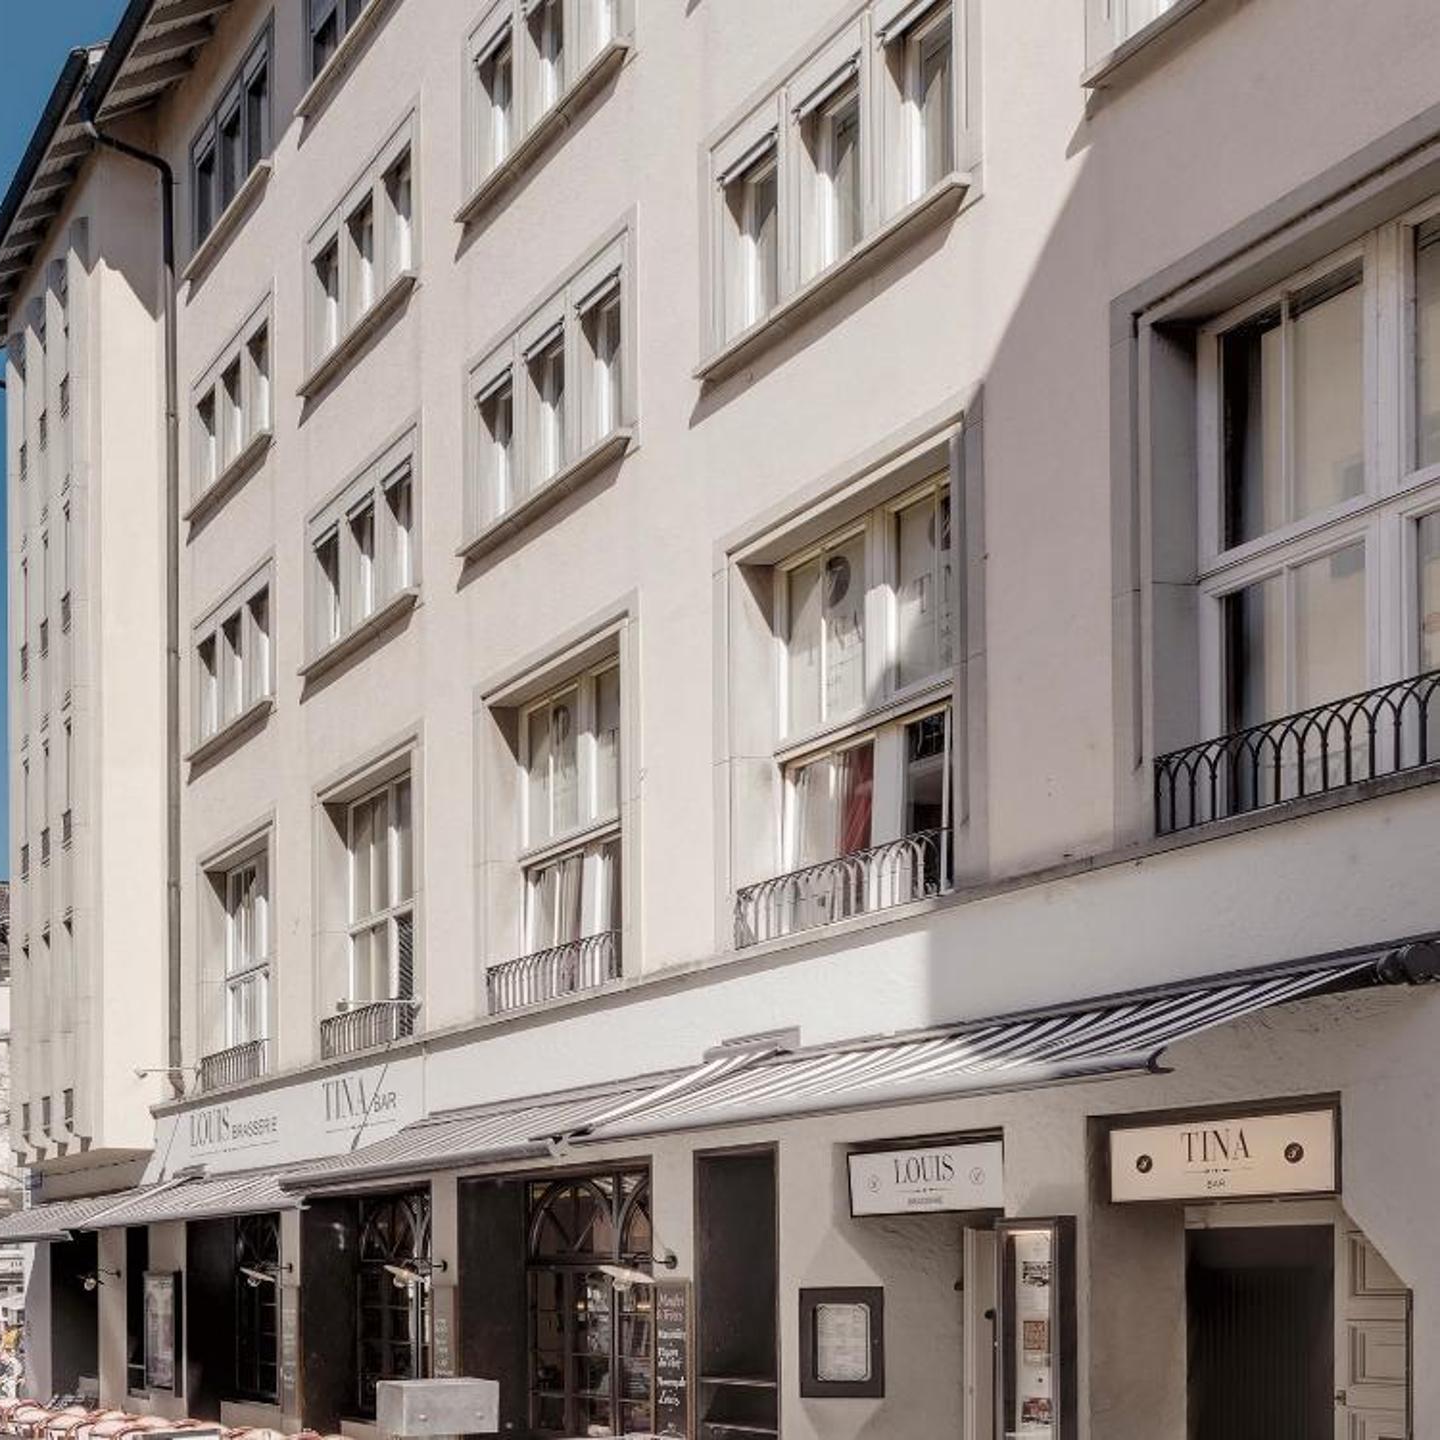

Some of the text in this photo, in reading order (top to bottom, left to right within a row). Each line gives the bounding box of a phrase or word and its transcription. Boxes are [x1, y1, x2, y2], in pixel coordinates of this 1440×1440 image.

[322, 1076, 398, 1121] TINA BAR
[190, 1106, 278, 1147] LOUIS BRASSERIE
[1180, 1128, 1252, 1163] TINA
[894, 1153, 956, 1184] LOUIS
